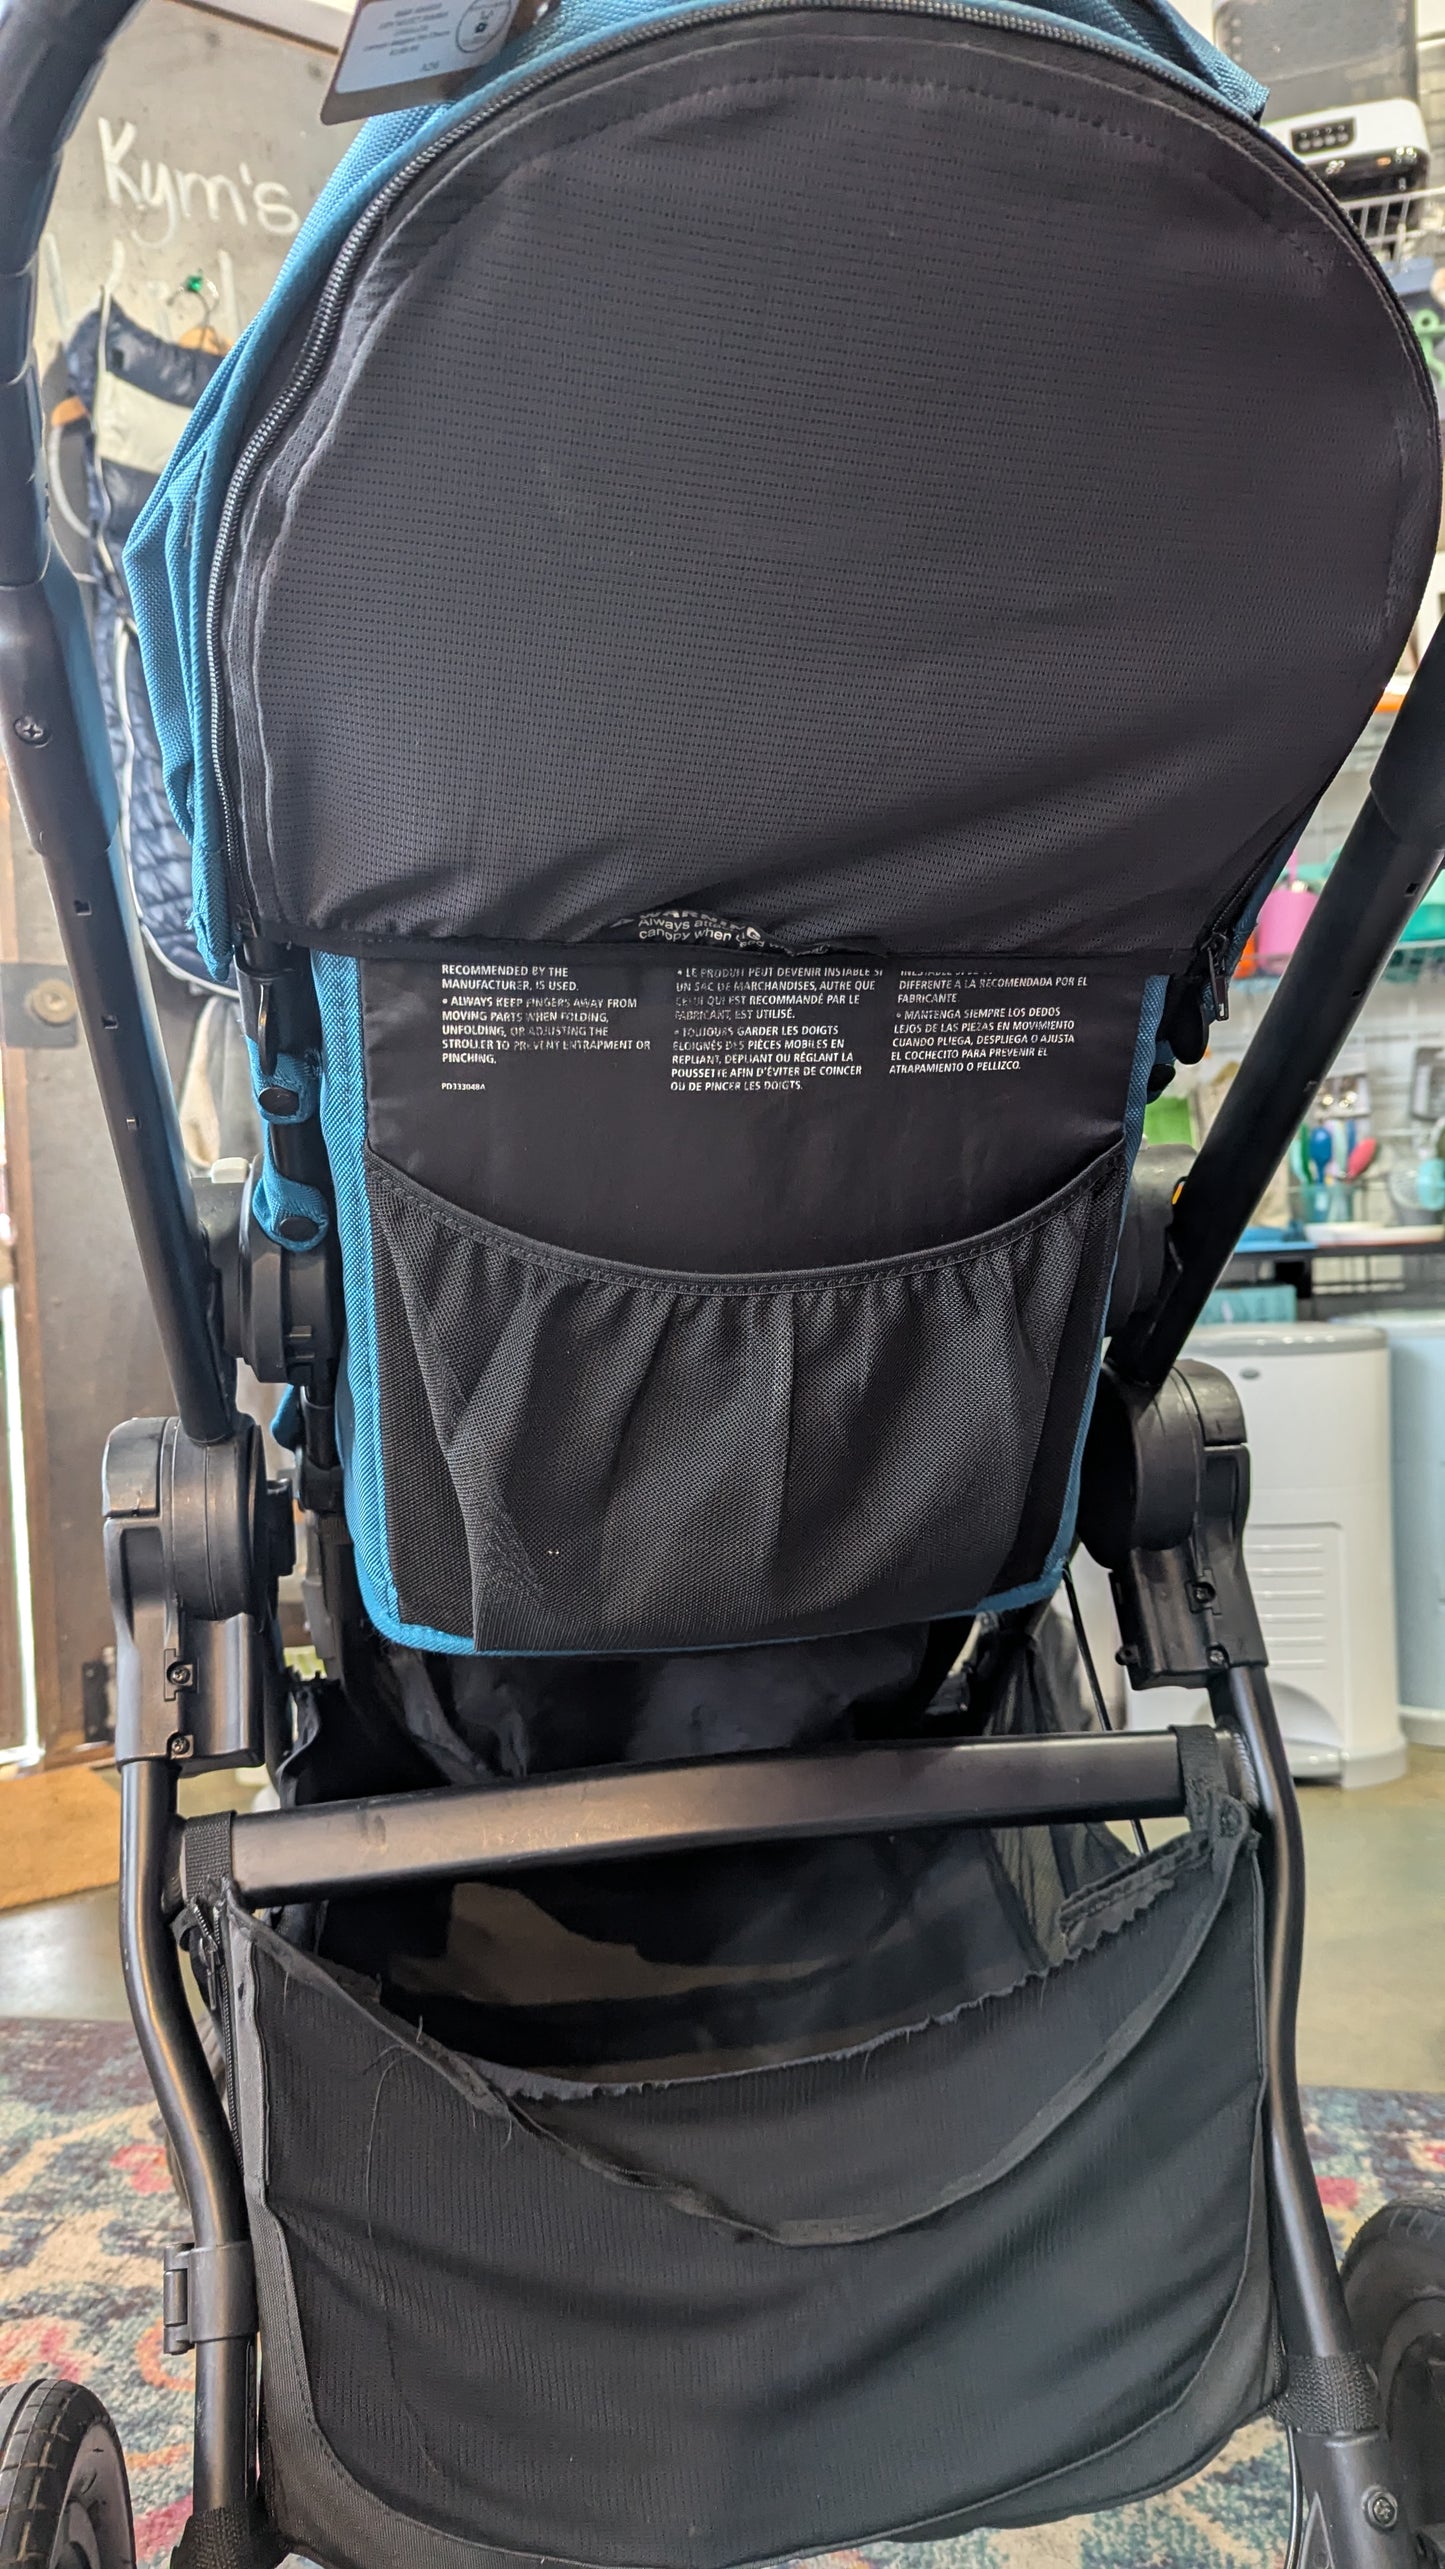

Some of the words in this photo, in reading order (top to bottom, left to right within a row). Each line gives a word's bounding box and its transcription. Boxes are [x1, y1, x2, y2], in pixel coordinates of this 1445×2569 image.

[98, 116, 300, 248] Kym's
[639, 918, 689, 931] Always
[639, 928, 690, 941] canopy
[695, 928, 732, 941] when
[441, 964, 528, 976] RECOMMENDED
[532, 967, 545, 976] BY
[549, 967, 568, 977] THE
[686, 968, 697, 977] LE
[701, 968, 745, 978] PRODUIT
[749, 967, 774, 977] PEUT
[777, 967, 821, 977] DEVENIR
[824, 968, 870, 977] INSTABLE
[536, 981, 545, 990] IS
[549, 982, 579, 991] USED.
[676, 982, 691, 991] UN
[695, 982, 714, 991] SAC
[718, 982, 731, 991] DE
[734, 981, 818, 992] MARCHANDISES,
[820, 981, 851, 991] AUTRE
[854, 980, 875, 991] QUE
[899, 979, 952, 990] DIFERENTE
[954, 979, 961, 988] A
[964, 979, 976, 988] LA
[979, 977, 1053, 988] RECOMENDADA
[1055, 977, 1075, 986] POR
[1078, 977, 1088, 986] EL
[451, 997, 493, 1007] ALWAYS
[496, 998, 523, 1007] KEEP
[526, 998, 570, 1008] FINGERS
[573, 998, 603, 1008] AWAY
[608, 998, 637, 1008] FROM
[676, 996, 703, 1006] CEUI
[707, 996, 726, 1007] QUI
[729, 996, 746, 1005] EST
[750, 993, 824, 1005] RECOMMANDÉ
[827, 995, 846, 1005] PAR
[849, 995, 860, 1004] LE
[442, 1011, 487, 1021] MOVING
[490, 1012, 523, 1022] PARTS
[525, 1012, 557, 1021] WHEN
[561, 1012, 609, 1023] FOLDING,
[735, 1010, 753, 1020] EST
[756, 1007, 795, 1019] UTILISÉ.
[904, 1009, 961, 1020] MANTENGA
[964, 1008, 1005, 1018] SIEMPRE
[1008, 1007, 1026, 1017] LOS
[1029, 1007, 1061, 1017] DEDOS
[442, 1025, 507, 1037] UNFOLDING,
[510, 1027, 525, 1036] OR
[529, 1026, 586, 1036] ADJUSTING
[589, 1026, 608, 1036] THE
[683, 1027, 734, 1037] TOUJOURS
[737, 1025, 779, 1036] GARDER
[782, 1025, 798, 1036] LES
[802, 1025, 839, 1035] DOIGTS
[894, 1023, 922, 1034] LEJOS
[925, 1023, 937, 1032] DE
[940, 1022, 958, 1032] LAS
[961, 1021, 994, 1032] PIEZAS
[997, 1021, 1009, 1030] EN
[1012, 1020, 1074, 1031] MOVIMIENTO
[442, 1039, 493, 1050] STROLLER
[496, 1040, 509, 1050] TO
[514, 1040, 559, 1050] PRVENT
[563, 1040, 632, 1050] ENTRAPMENT
[636, 1041, 650, 1050] OR
[748, 1038, 781, 1049] PIÈCES
[785, 1039, 827, 1049] MOBILES
[831, 1039, 845, 1048] EN
[892, 1037, 934, 1047] CUANDO
[937, 1036, 974, 1046] PLIEGA,
[976, 1035, 1028, 1045] DESPLIEGA
[1031, 1035, 1038, 1043] O
[1040, 1034, 1075, 1044] AJUSTA
[442, 1053, 497, 1064] PINCHING.
[672, 1055, 721, 1065] REPLIANT,
[775, 1054, 791, 1063] OU
[793, 1052, 838, 1063] RÉGLANT
[841, 1053, 854, 1062] LA
[891, 1051, 901, 1061] EL
[905, 1049, 958, 1060] COCHECITO
[961, 1048, 986, 1058] PARA
[989, 1047, 1035, 1057] PREVENIR
[1038, 1047, 1048, 1057] EL
[671, 1068, 728, 1078] POUSSETTE
[730, 1068, 753, 1078] AFIN
[756, 1065, 800, 1077] D'ÉVITER
[803, 1066, 816, 1076] DE
[820, 1066, 862, 1076] COINCER
[889, 1063, 964, 1074] ATRAPAMIENTO
[966, 1063, 974, 1071] O
[976, 1061, 1021, 1071] PELLIZCO.
[671, 1082, 687, 1091] OU
[689, 1082, 702, 1091] DE
[705, 1082, 741, 1091] PINCER
[744, 1081, 761, 1091] LES
[764, 1080, 803, 1091] DOIGTS.
